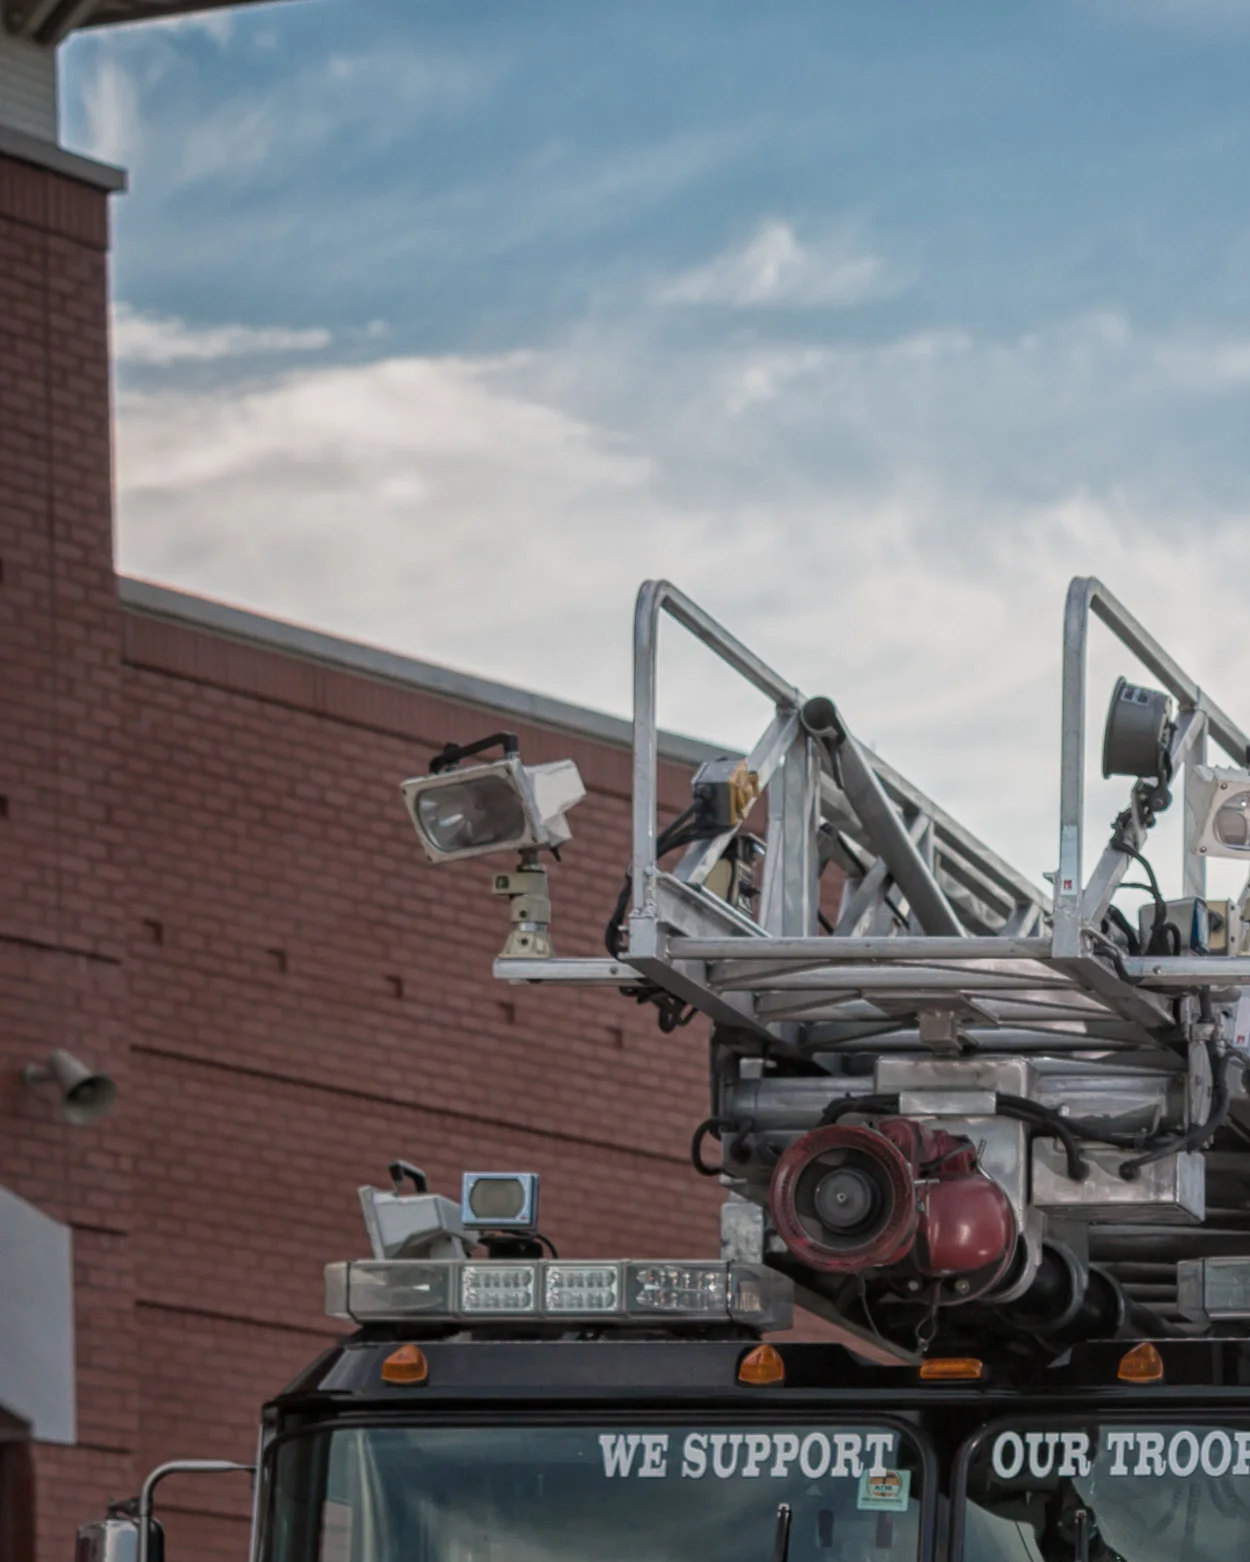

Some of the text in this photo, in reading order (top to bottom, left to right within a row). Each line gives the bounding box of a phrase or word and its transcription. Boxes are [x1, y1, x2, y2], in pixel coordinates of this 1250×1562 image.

[599, 1434, 668, 1478] WE
[682, 1433, 893, 1478] SUPPORT
[992, 1432, 1091, 1478] OUR
